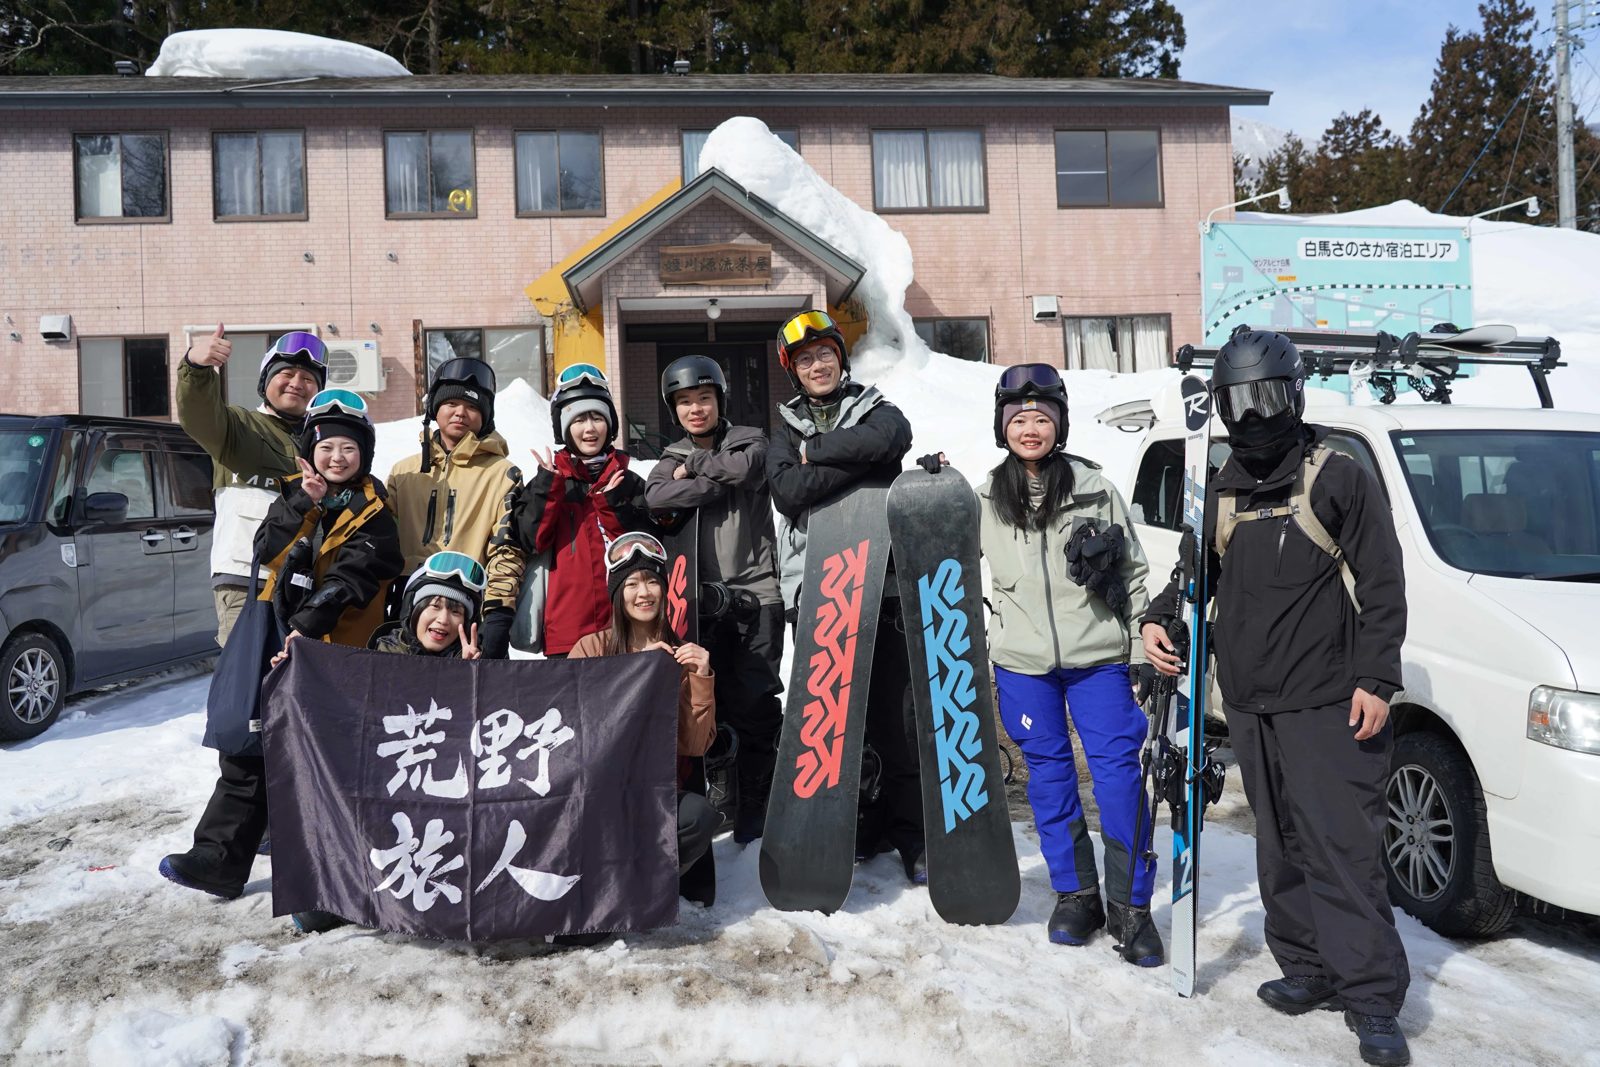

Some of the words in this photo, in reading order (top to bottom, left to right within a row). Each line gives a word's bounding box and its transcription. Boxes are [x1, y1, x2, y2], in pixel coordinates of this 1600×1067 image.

[1305, 240, 1452, 259] 白馬さのさか宿泊エリア
[1184, 391, 1209, 417] R
[376, 697, 574, 798] 荒野
[370, 812, 582, 912] 旅人
